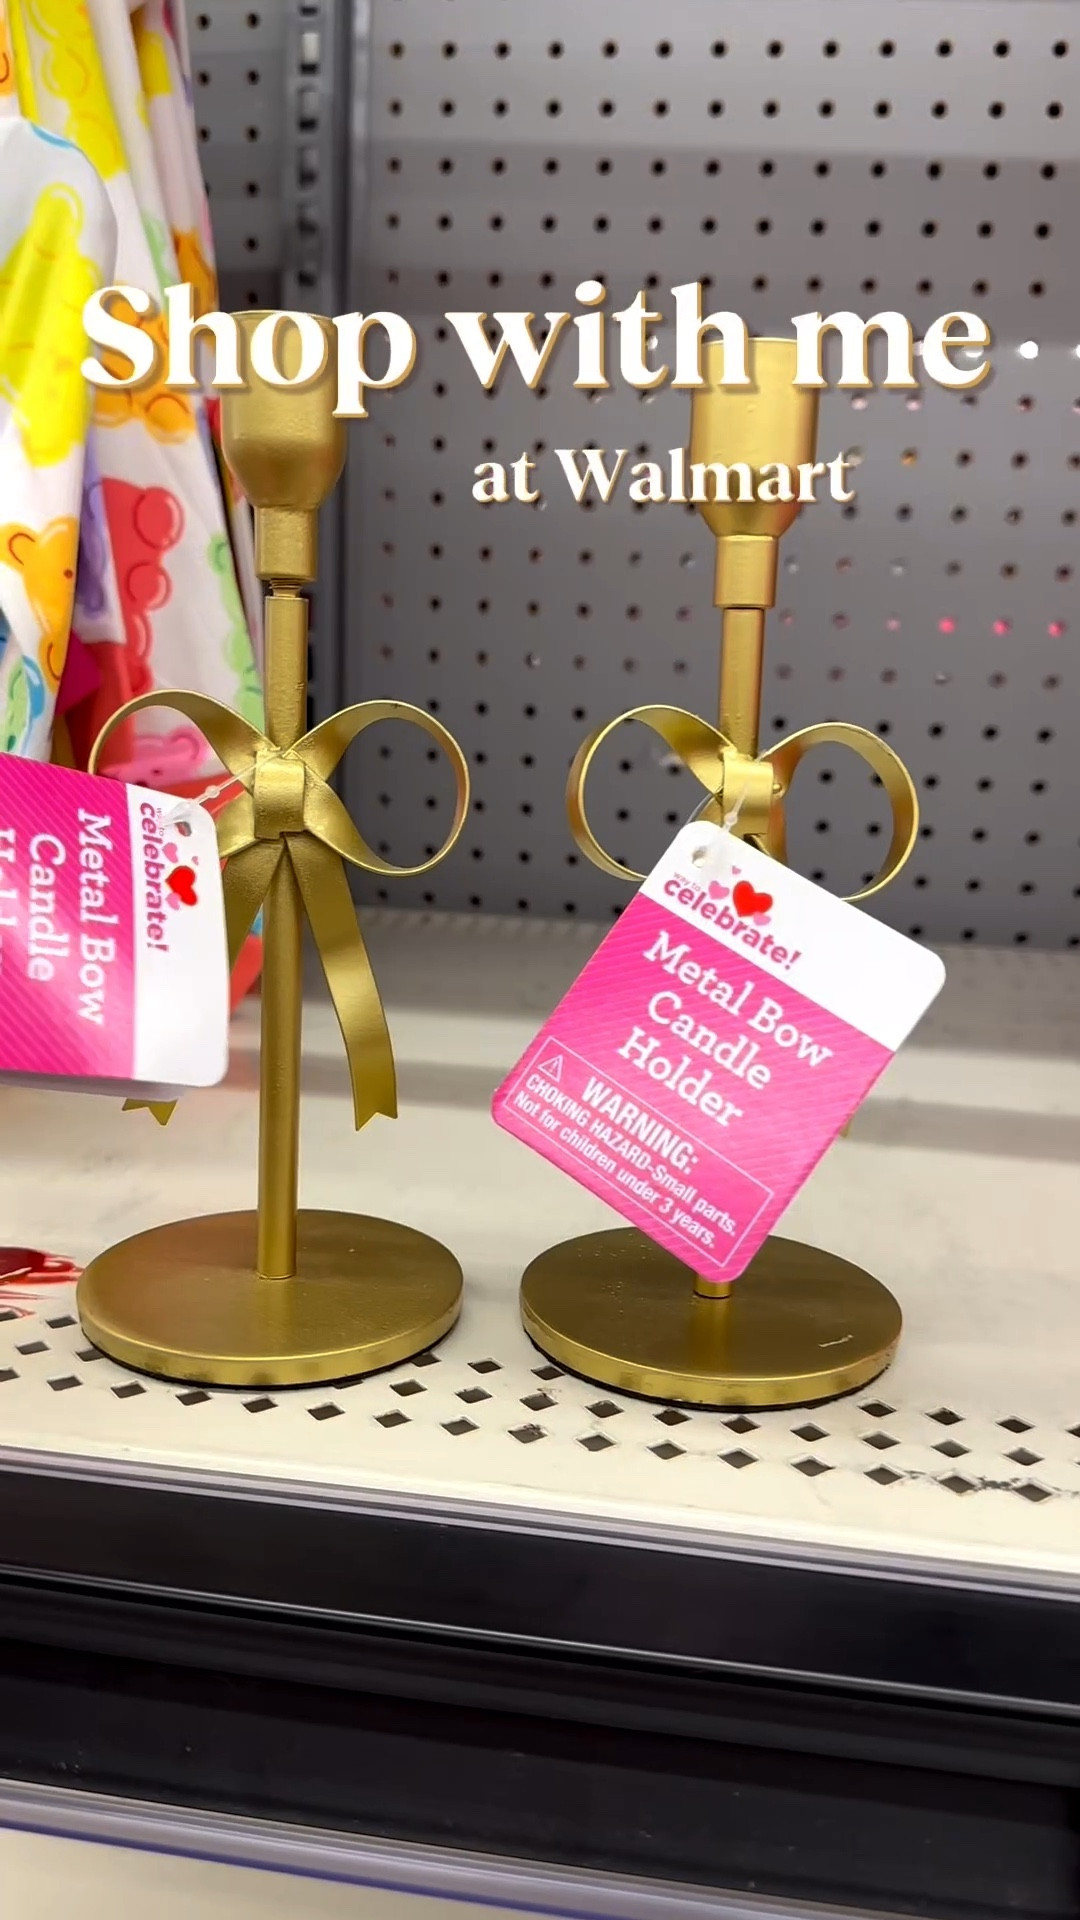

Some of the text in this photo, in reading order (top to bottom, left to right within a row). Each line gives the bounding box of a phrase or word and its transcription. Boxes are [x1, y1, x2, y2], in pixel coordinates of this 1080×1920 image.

[27, 833, 69, 982] Candle
[77, 808, 120, 1025] Metal Bow
[139, 802, 170, 953] celebrate!
[664, 879, 802, 970] celebrate!
[642, 930, 834, 1068] Metal Bow
[648, 991, 771, 1090] Candle
[581, 1076, 699, 1175] WARNING:
[617, 1026, 744, 1127] Holder
[513, 1090, 716, 1249] Not for children under 3 years.
[525, 1073, 592, 1126] CHOKING
[693, 1195, 736, 1237] parts.
